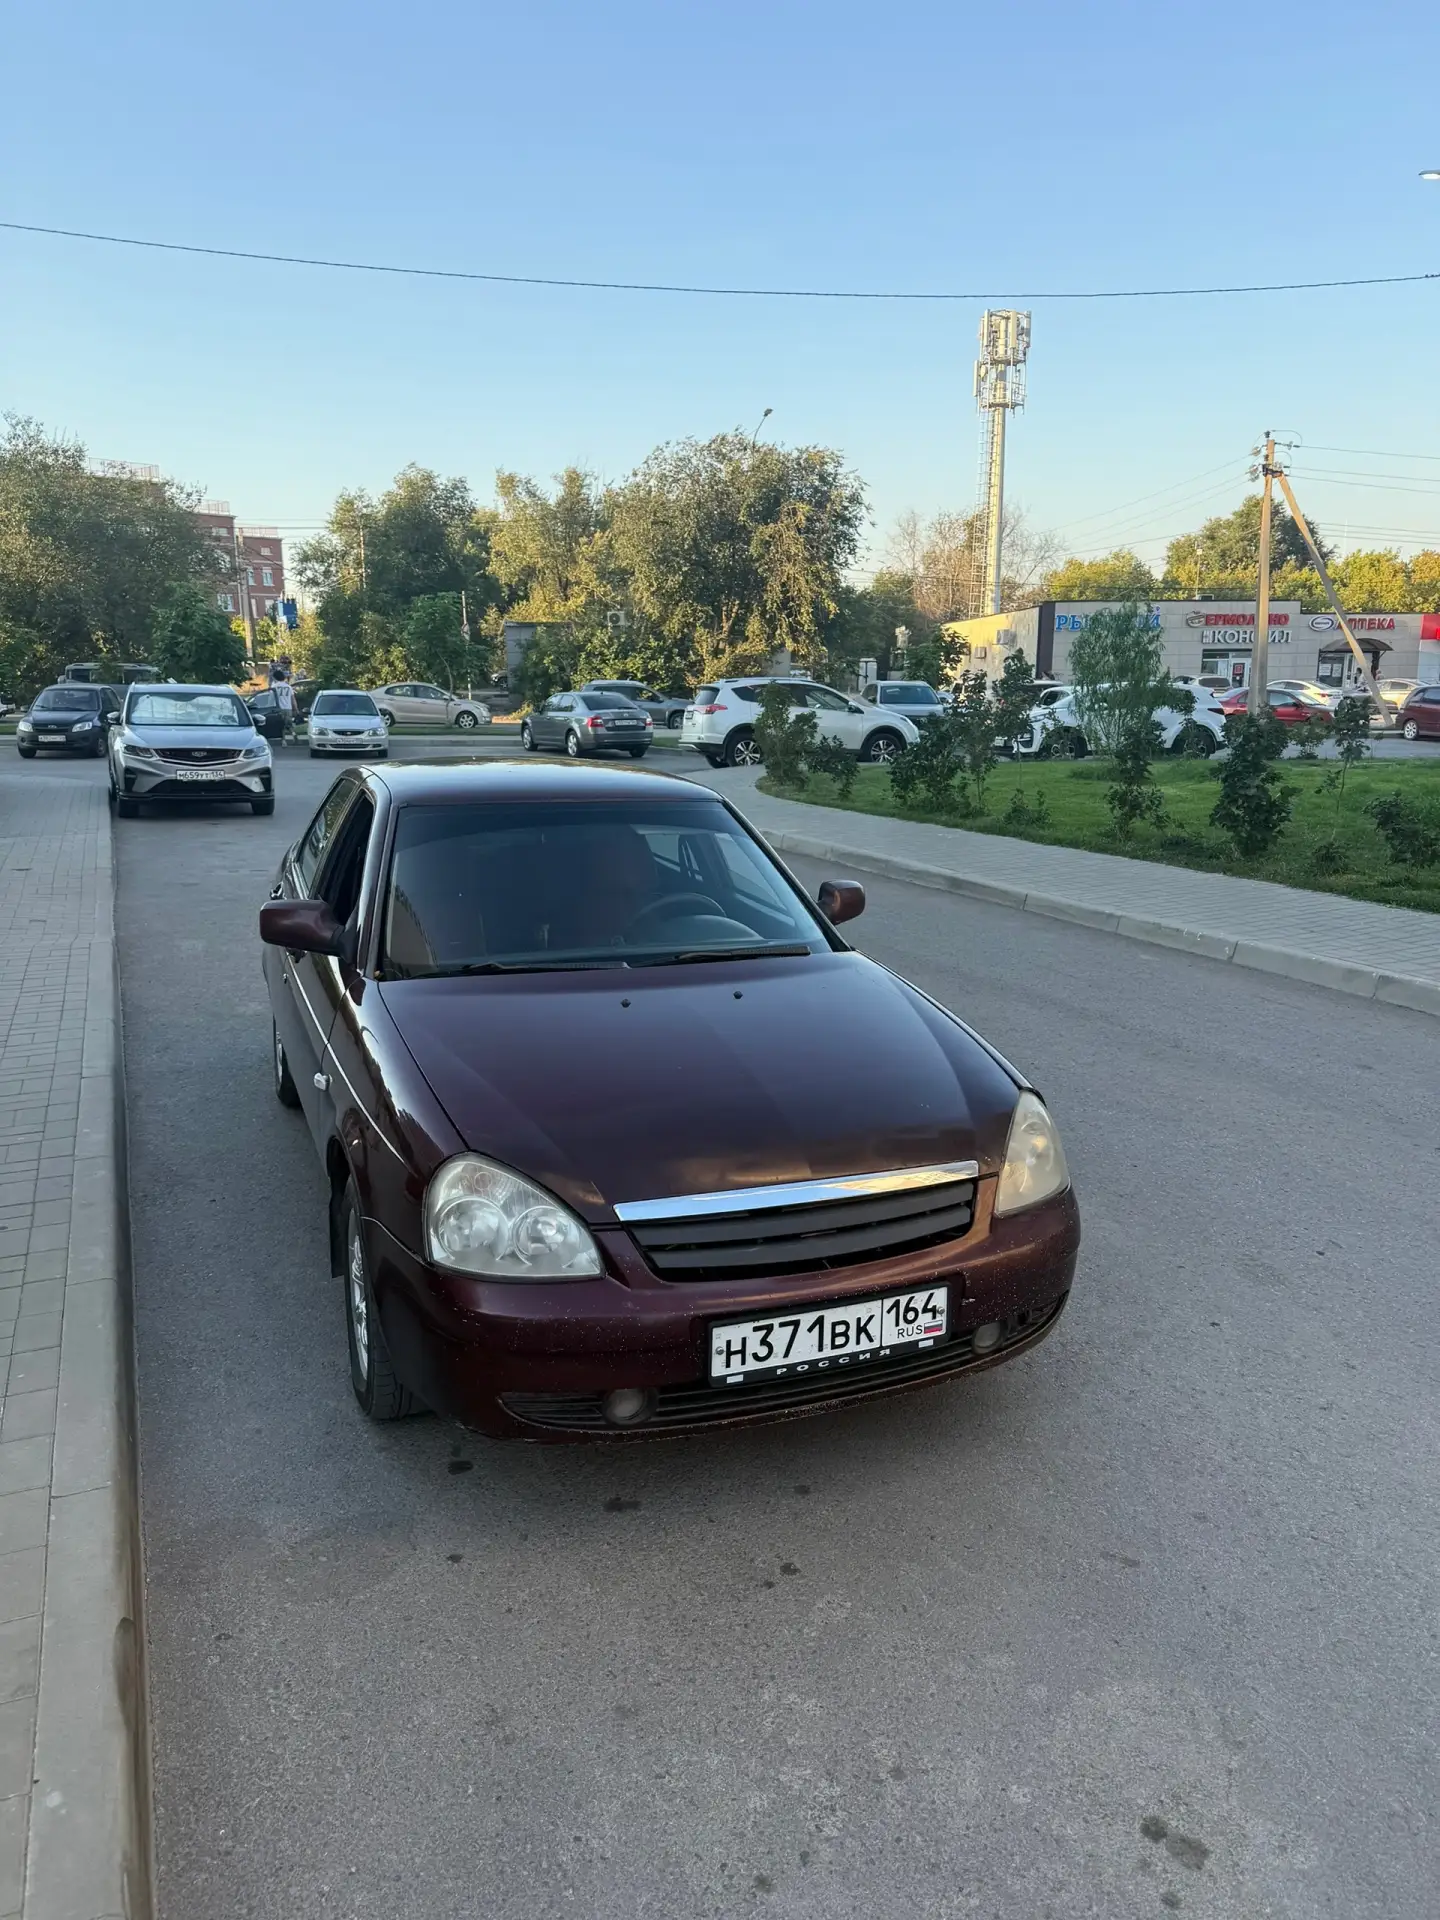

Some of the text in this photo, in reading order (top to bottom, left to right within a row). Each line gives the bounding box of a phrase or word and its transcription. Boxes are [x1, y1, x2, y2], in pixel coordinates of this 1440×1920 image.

[277, 686, 290, 697] 77
[725, 1292, 938, 1369] Н371ВК 164
[897, 1325, 923, 1339] RUS
[776, 1348, 891, 1376] РОССИЯ
